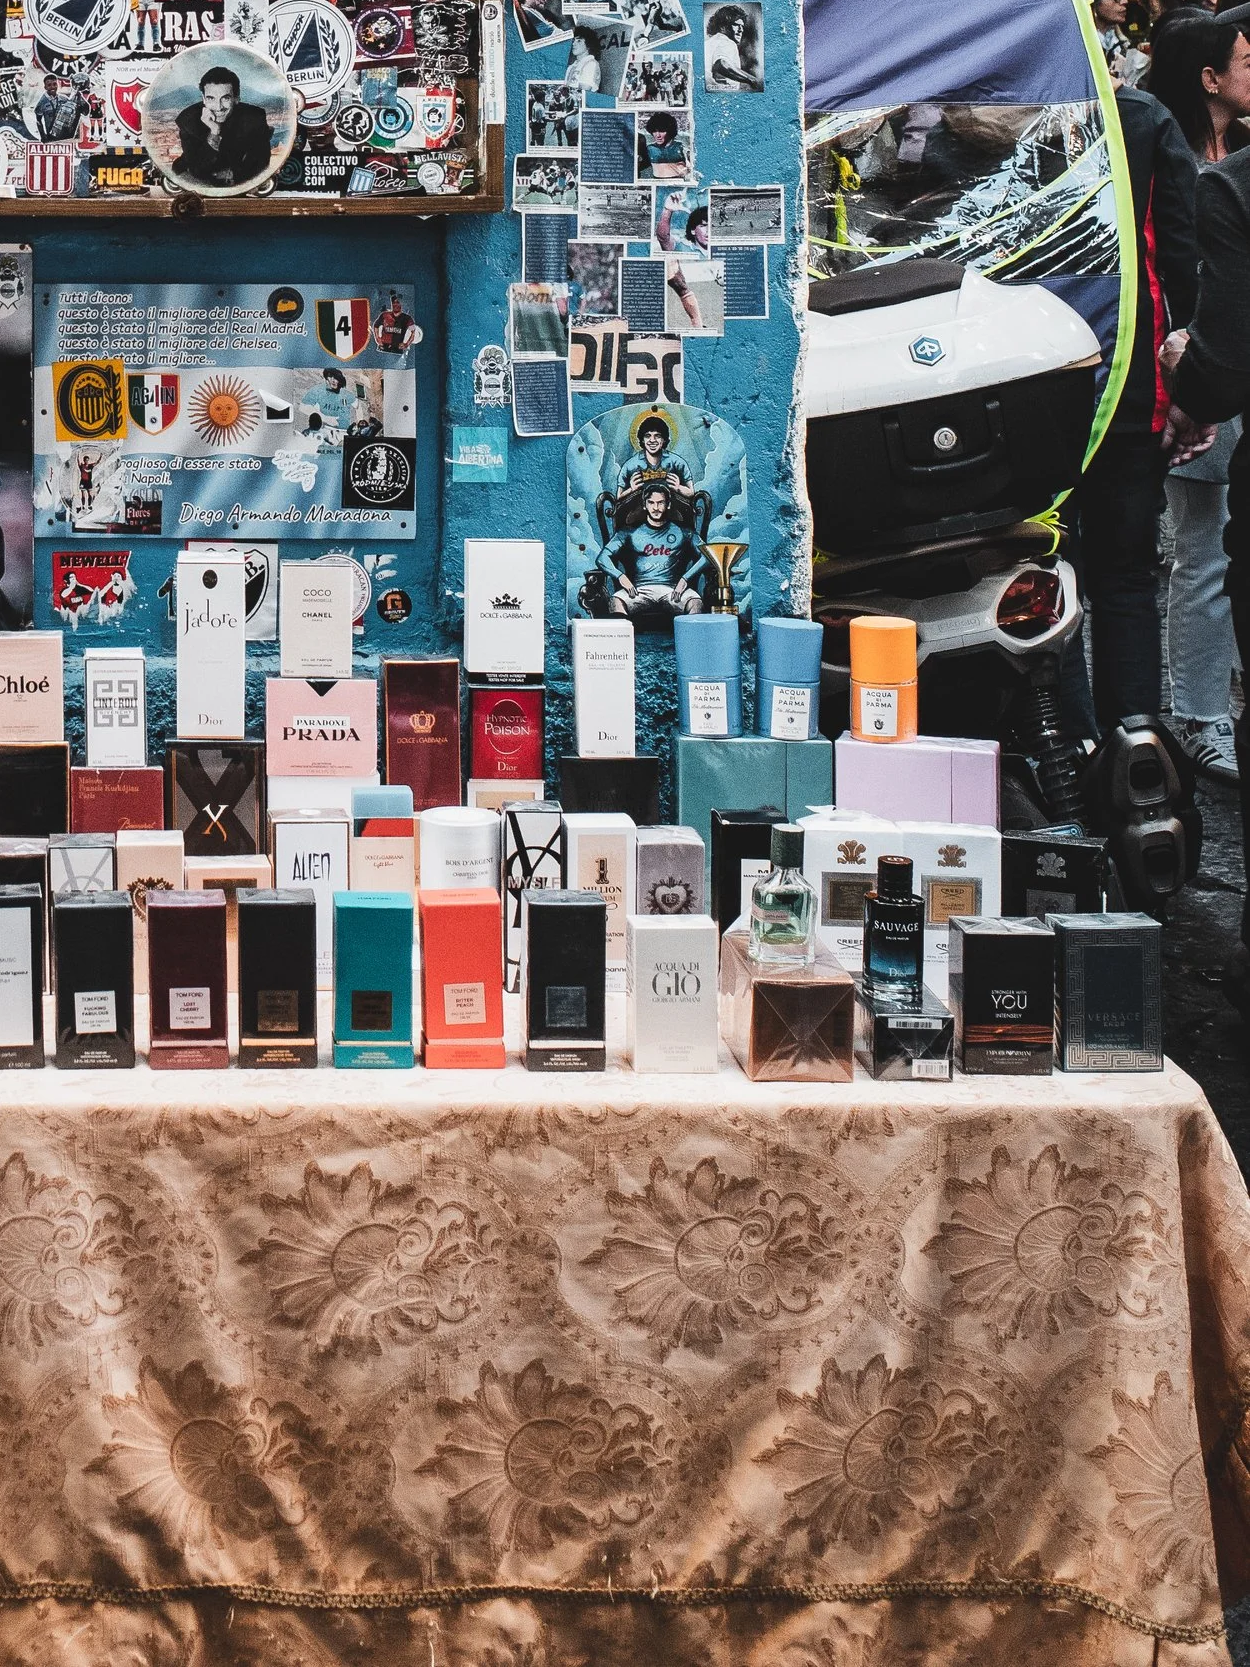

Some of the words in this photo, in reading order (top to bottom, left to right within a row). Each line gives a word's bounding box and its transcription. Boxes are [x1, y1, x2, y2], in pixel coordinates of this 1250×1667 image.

[45, 12, 83, 38] BERLIN
[286, 70, 325, 84] BERLIN
[29, 144, 71, 155] ALUMNI
[304, 155, 358, 166] COLECTIVO
[304, 166, 346, 176] SONORO
[304, 176, 326, 186] COM
[58, 292, 88, 305] Tutti
[90, 292, 132, 305] dicono:
[58, 308, 99, 322] questo
[101, 308, 110, 318] è
[111, 308, 145, 318] stato
[147, 308, 156, 318] il
[158, 308, 209, 322] migliore
[210, 308, 230, 319] del
[58, 323, 99, 336] questo
[101, 323, 110, 333] è
[111, 323, 145, 333] stato
[147, 323, 156, 333] il
[158, 323, 209, 336] migliore
[210, 323, 230, 334] del
[231, 323, 258, 334] Real
[260, 323, 308, 336] Madrid,
[335, 315, 352, 336] 4
[58, 338, 99, 351] questo
[101, 338, 110, 348] è
[111, 338, 145, 348] stato
[147, 338, 156, 348] il
[158, 338, 209, 351] migliore
[210, 338, 230, 349] del
[231, 338, 282, 351] Chelsea,
[158, 352, 216, 366] migliore...
[170, 457, 182, 469] di
[184, 459, 226, 470] essere
[228, 459, 262, 470] stato
[130, 472, 173, 486] Napoli.
[179, 503, 224, 525] Diego
[227, 503, 302, 523] Armando
[305, 504, 393, 523] Maradona
[302, 588, 332, 597] COCO
[183, 599, 238, 637] j'adore
[301, 611, 333, 619] CHANEL
[585, 650, 629, 663] Fahrenheit
[92, 697, 139, 709] L'INTERDIT
[197, 713, 224, 727] Dior
[296, 718, 347, 727] PARADOXE
[486, 714, 528, 725] HYPNOTIC
[282, 726, 361, 742] PRADA
[483, 723, 530, 737] POISON
[598, 731, 618, 742] Dior
[396, 737, 417, 745] DOLCE
[419, 736, 449, 744] GABBANA
[496, 761, 518, 773] Dior
[78, 784, 103, 792] Francis
[105, 784, 140, 793] Kurkdjian
[292, 851, 332, 881] ALIEN
[464, 857, 494, 866] D'ARGENT
[873, 919, 920, 933] SAUVAGE
[653, 962, 686, 971] ACQUA
[990, 994, 1027, 1010] YOU
[1087, 1012, 1142, 1023] VERSACE
